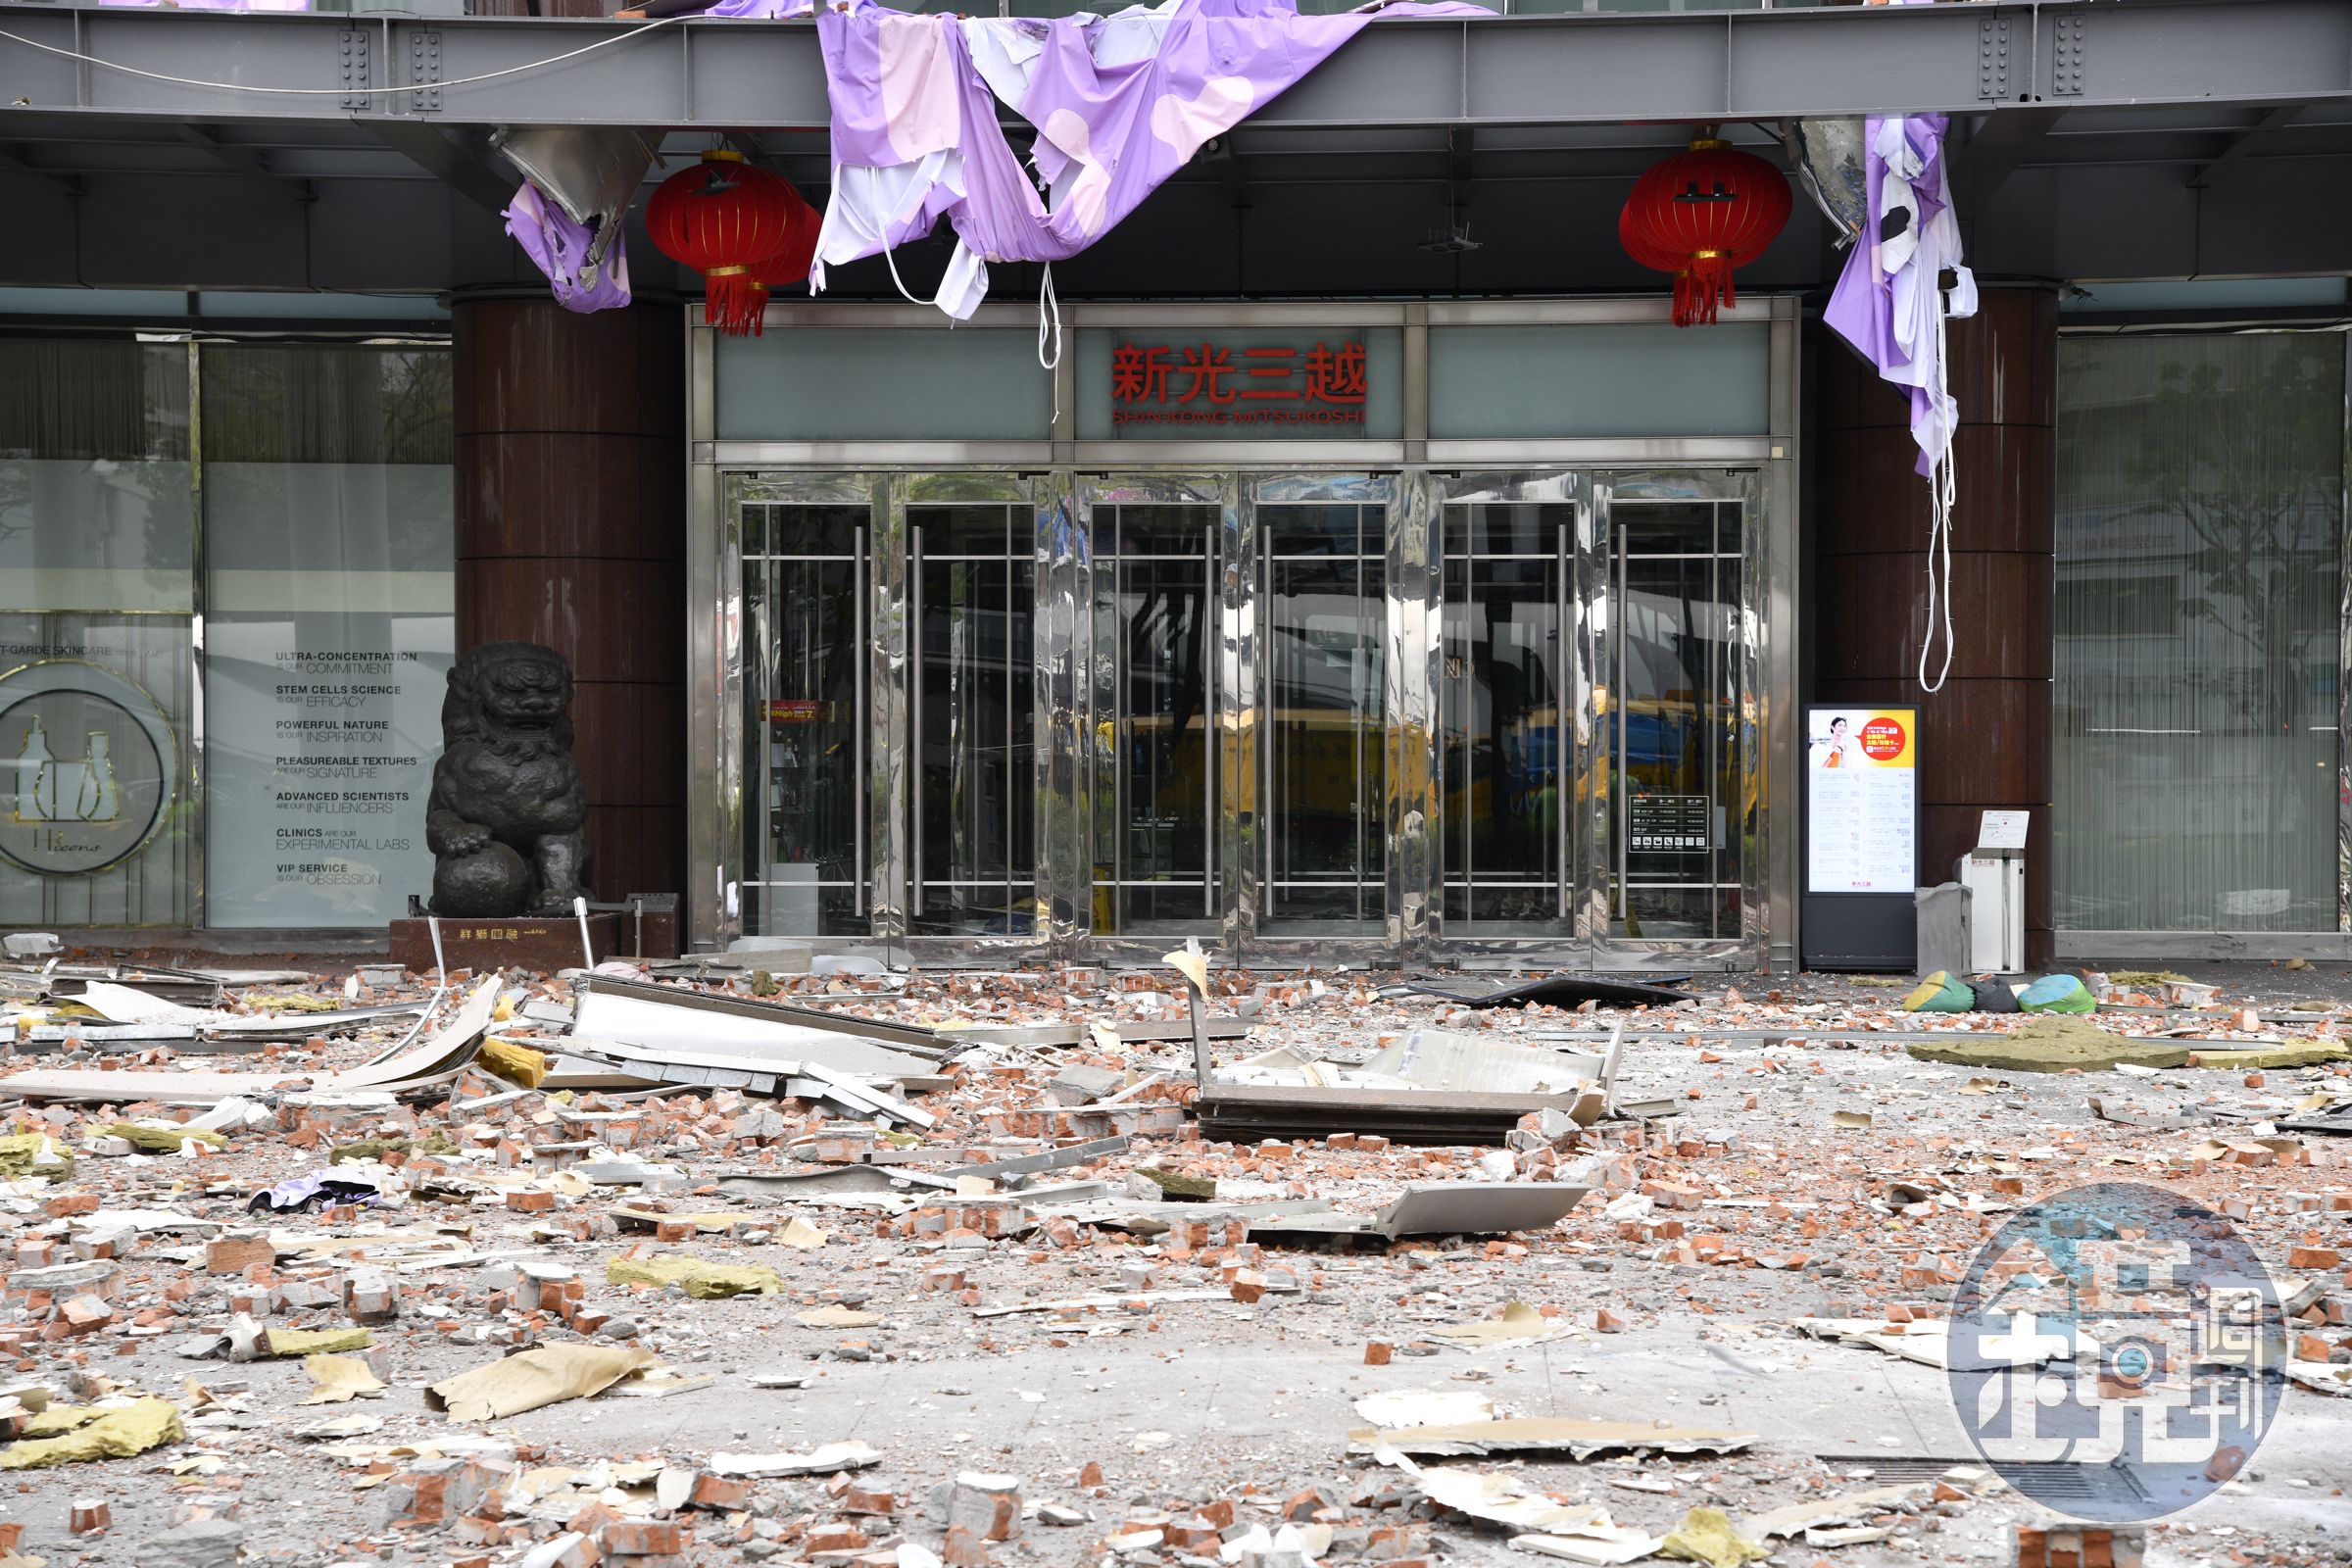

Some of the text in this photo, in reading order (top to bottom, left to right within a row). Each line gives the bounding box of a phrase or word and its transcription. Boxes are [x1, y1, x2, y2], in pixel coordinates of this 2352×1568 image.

[1111, 341, 1368, 405] 新光三越
[1112, 409, 1366, 424] SHIN KONG MITSUKOSHI
[53, 645, 112, 657] SKINCARE
[275, 652, 417, 662] ULTRA-CONCENTRATION
[306, 662, 394, 674] COMMITMENT
[275, 685, 401, 695] STEM CELLS SCIENCE
[306, 696, 367, 708] EFFICACY
[275, 720, 389, 729] POWERFUL NATURE
[306, 731, 383, 743] INSPIRATION
[275, 757, 417, 766] PLEASUREABLE TEXTURES
[306, 766, 377, 779] SIGNATURE
[275, 792, 410, 801] ADVANCED SCIENTISTS
[306, 802, 394, 814] INFLUENCERS
[276, 828, 322, 838] CLINICS
[275, 838, 411, 851] EXPERIMENTAL LABS
[276, 863, 348, 873] VIP SERVICE
[306, 873, 381, 886] OBSESSION
